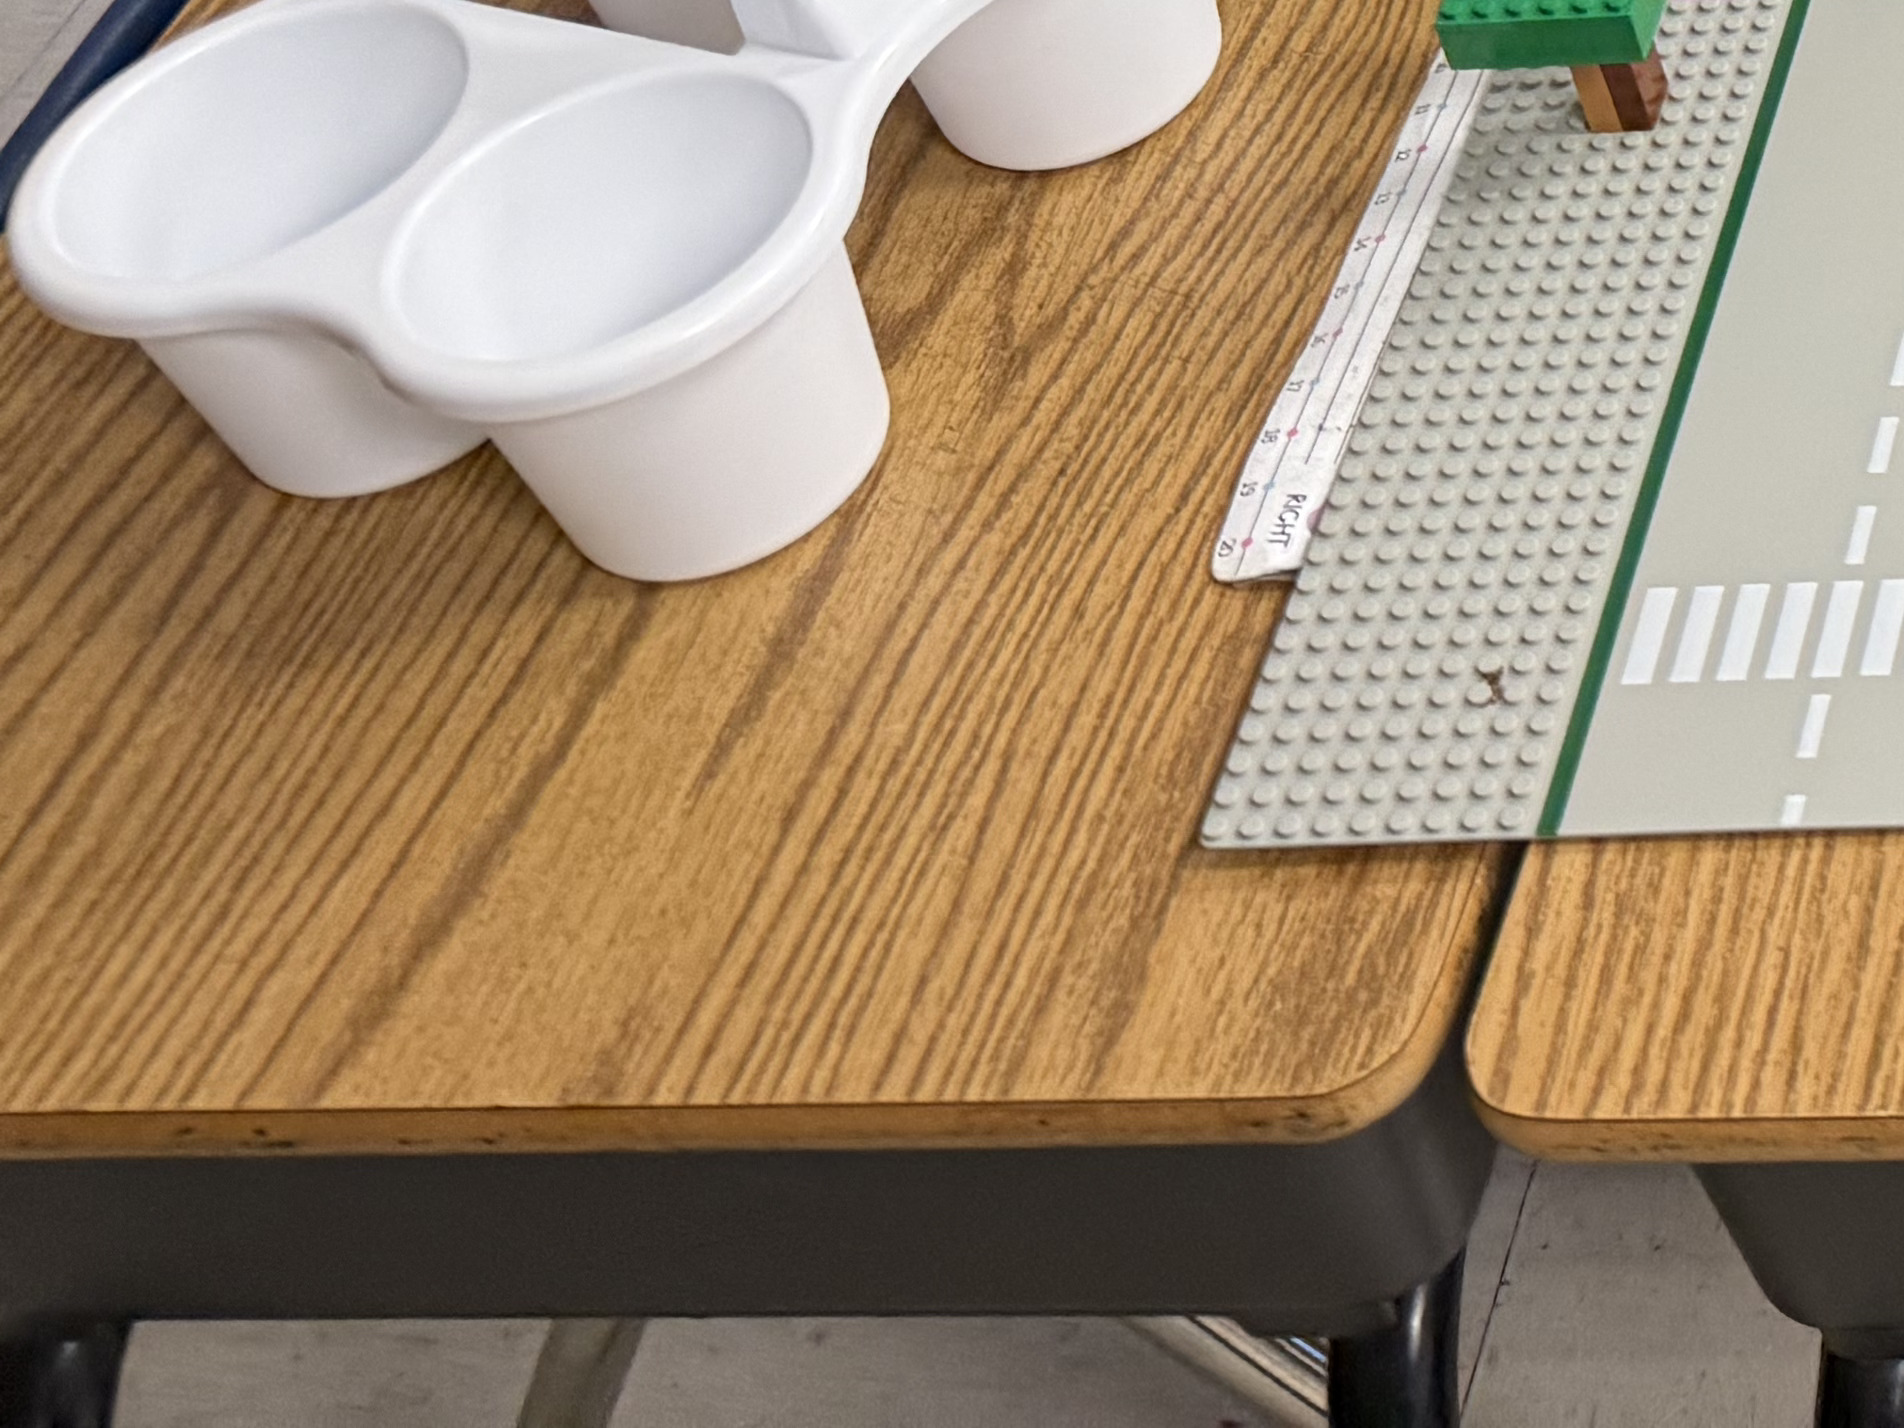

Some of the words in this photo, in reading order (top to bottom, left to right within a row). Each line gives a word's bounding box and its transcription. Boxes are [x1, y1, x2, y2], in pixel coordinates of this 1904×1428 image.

[1261, 428, 1282, 444] 18
[1240, 481, 1259, 497] 19
[1266, 493, 1307, 549] RIGHT
[1218, 538, 1237, 558] 20
